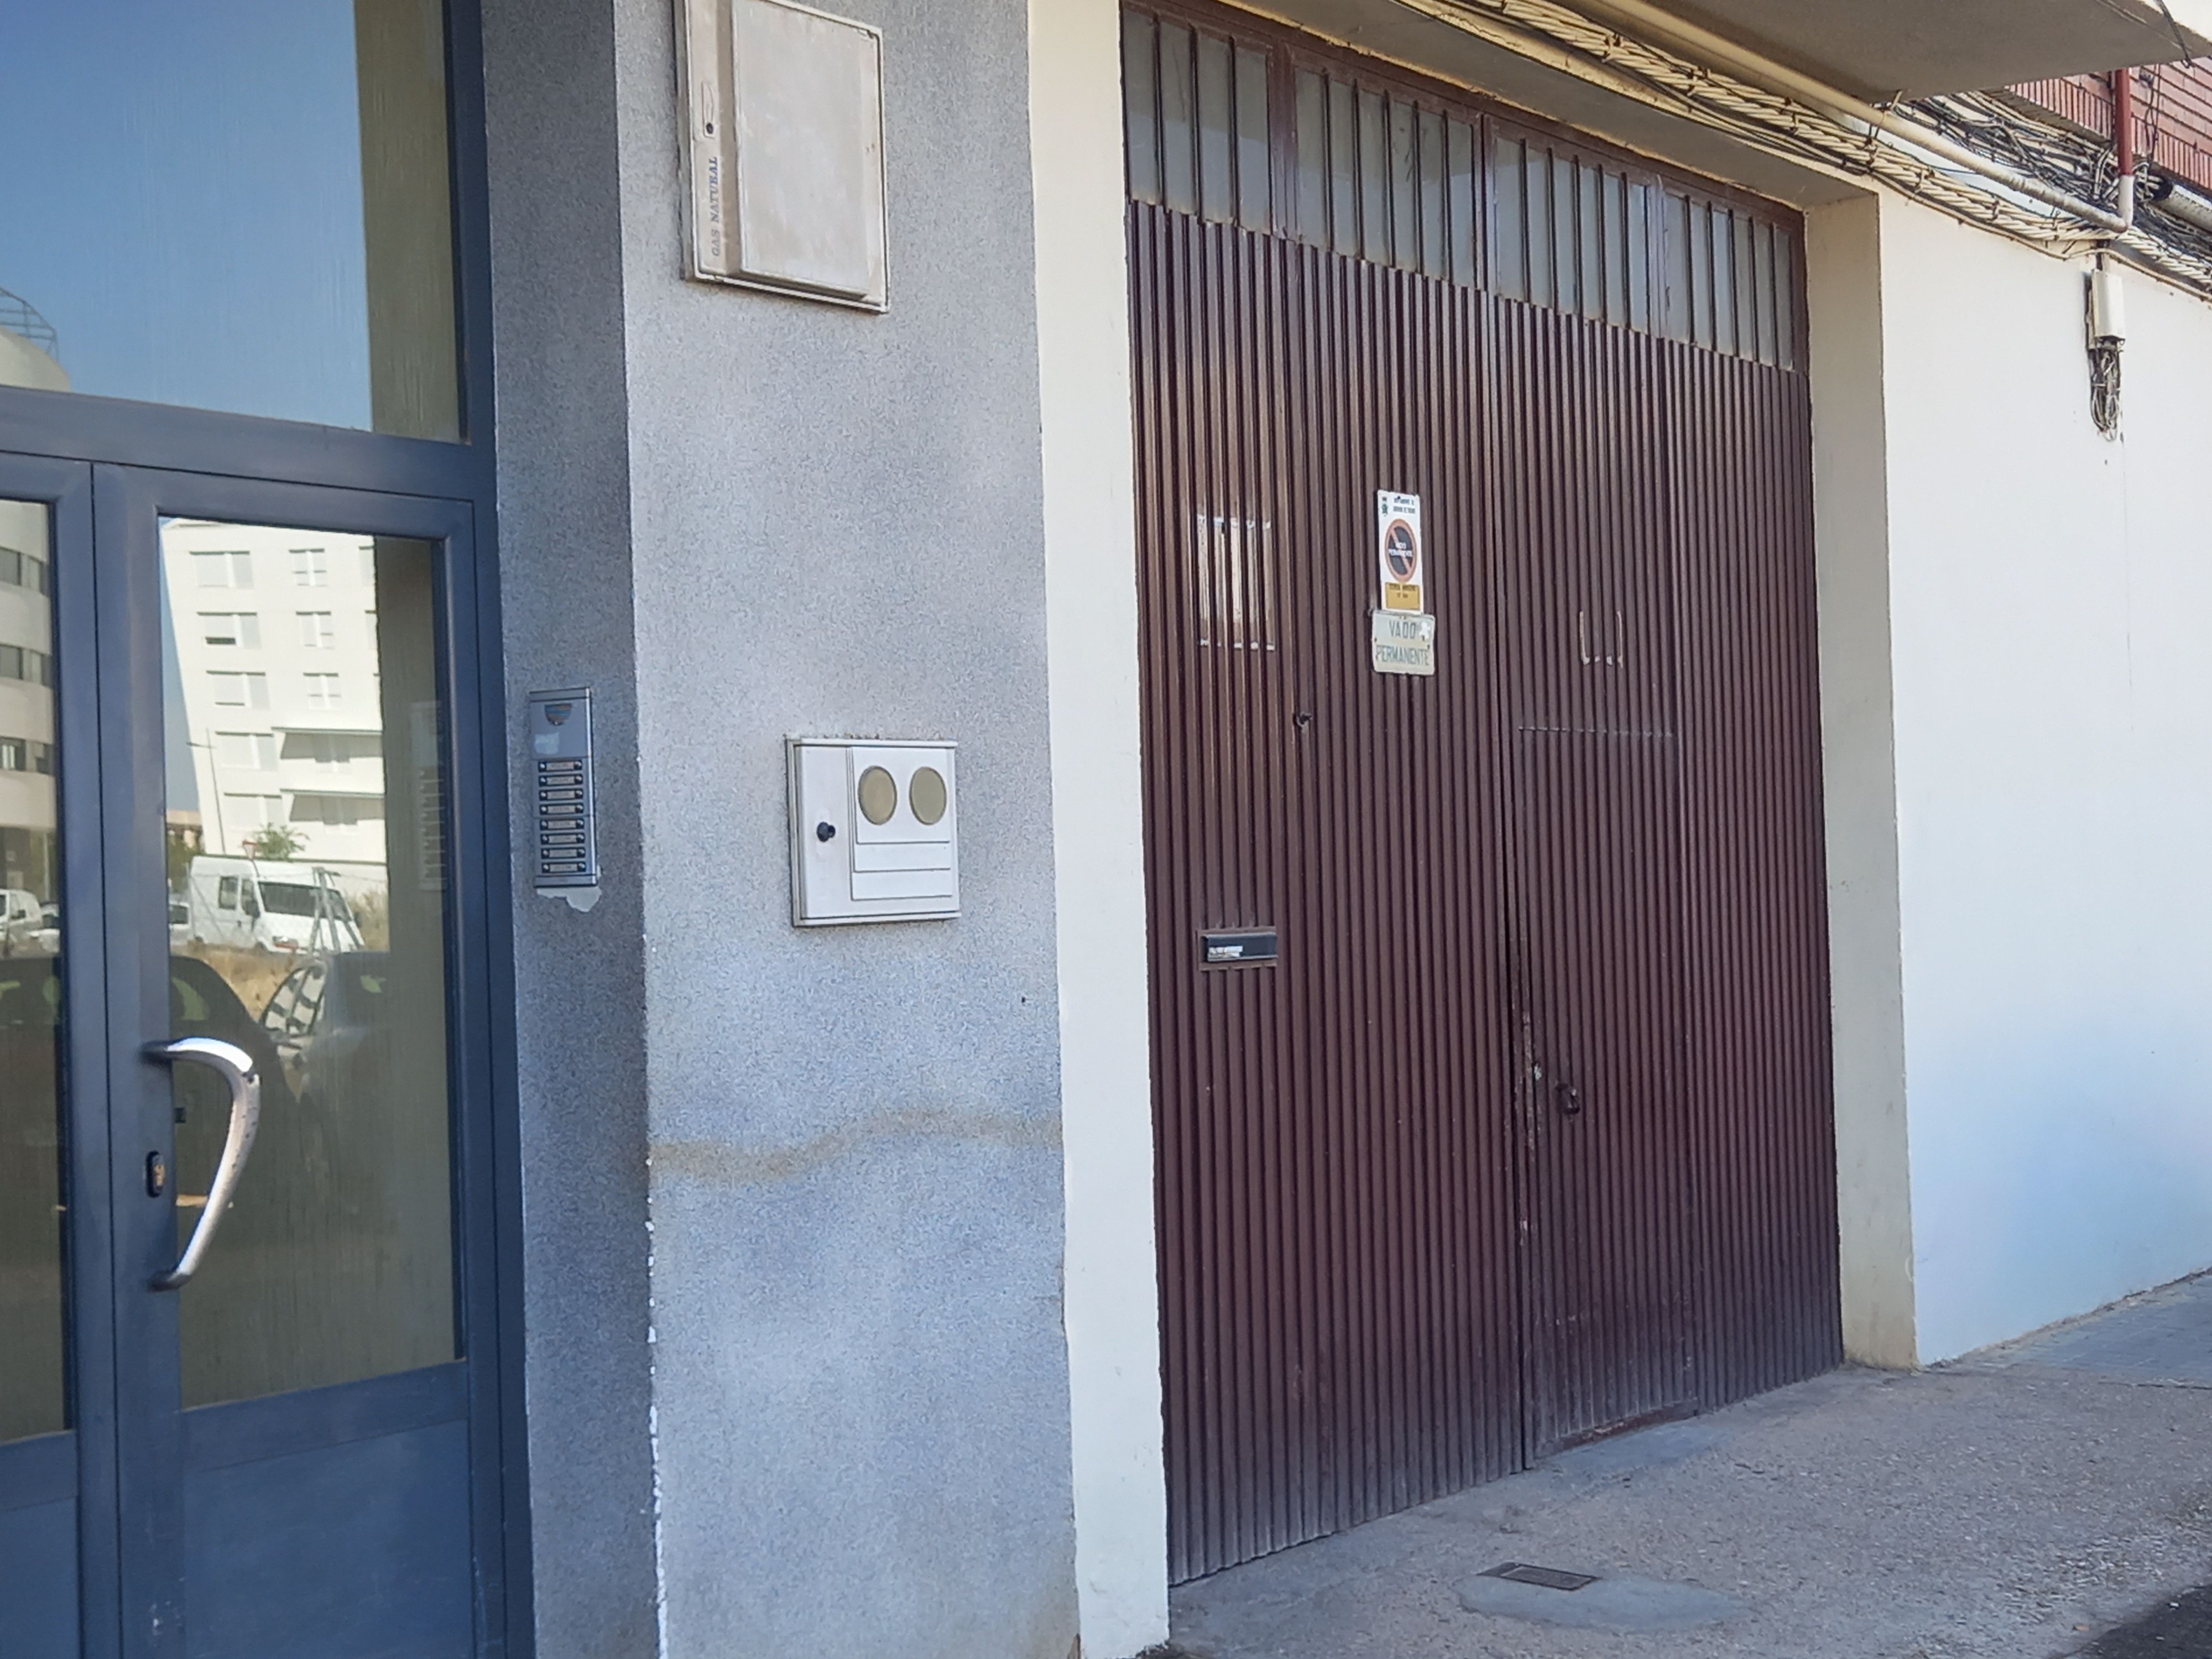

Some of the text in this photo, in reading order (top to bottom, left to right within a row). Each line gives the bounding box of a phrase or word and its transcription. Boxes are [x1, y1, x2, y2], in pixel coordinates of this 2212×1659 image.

[708, 156, 720, 256] GAS NATURAL
[1389, 620, 1416, 639] VADO
[1375, 645, 1430, 666] PERMANENTE
